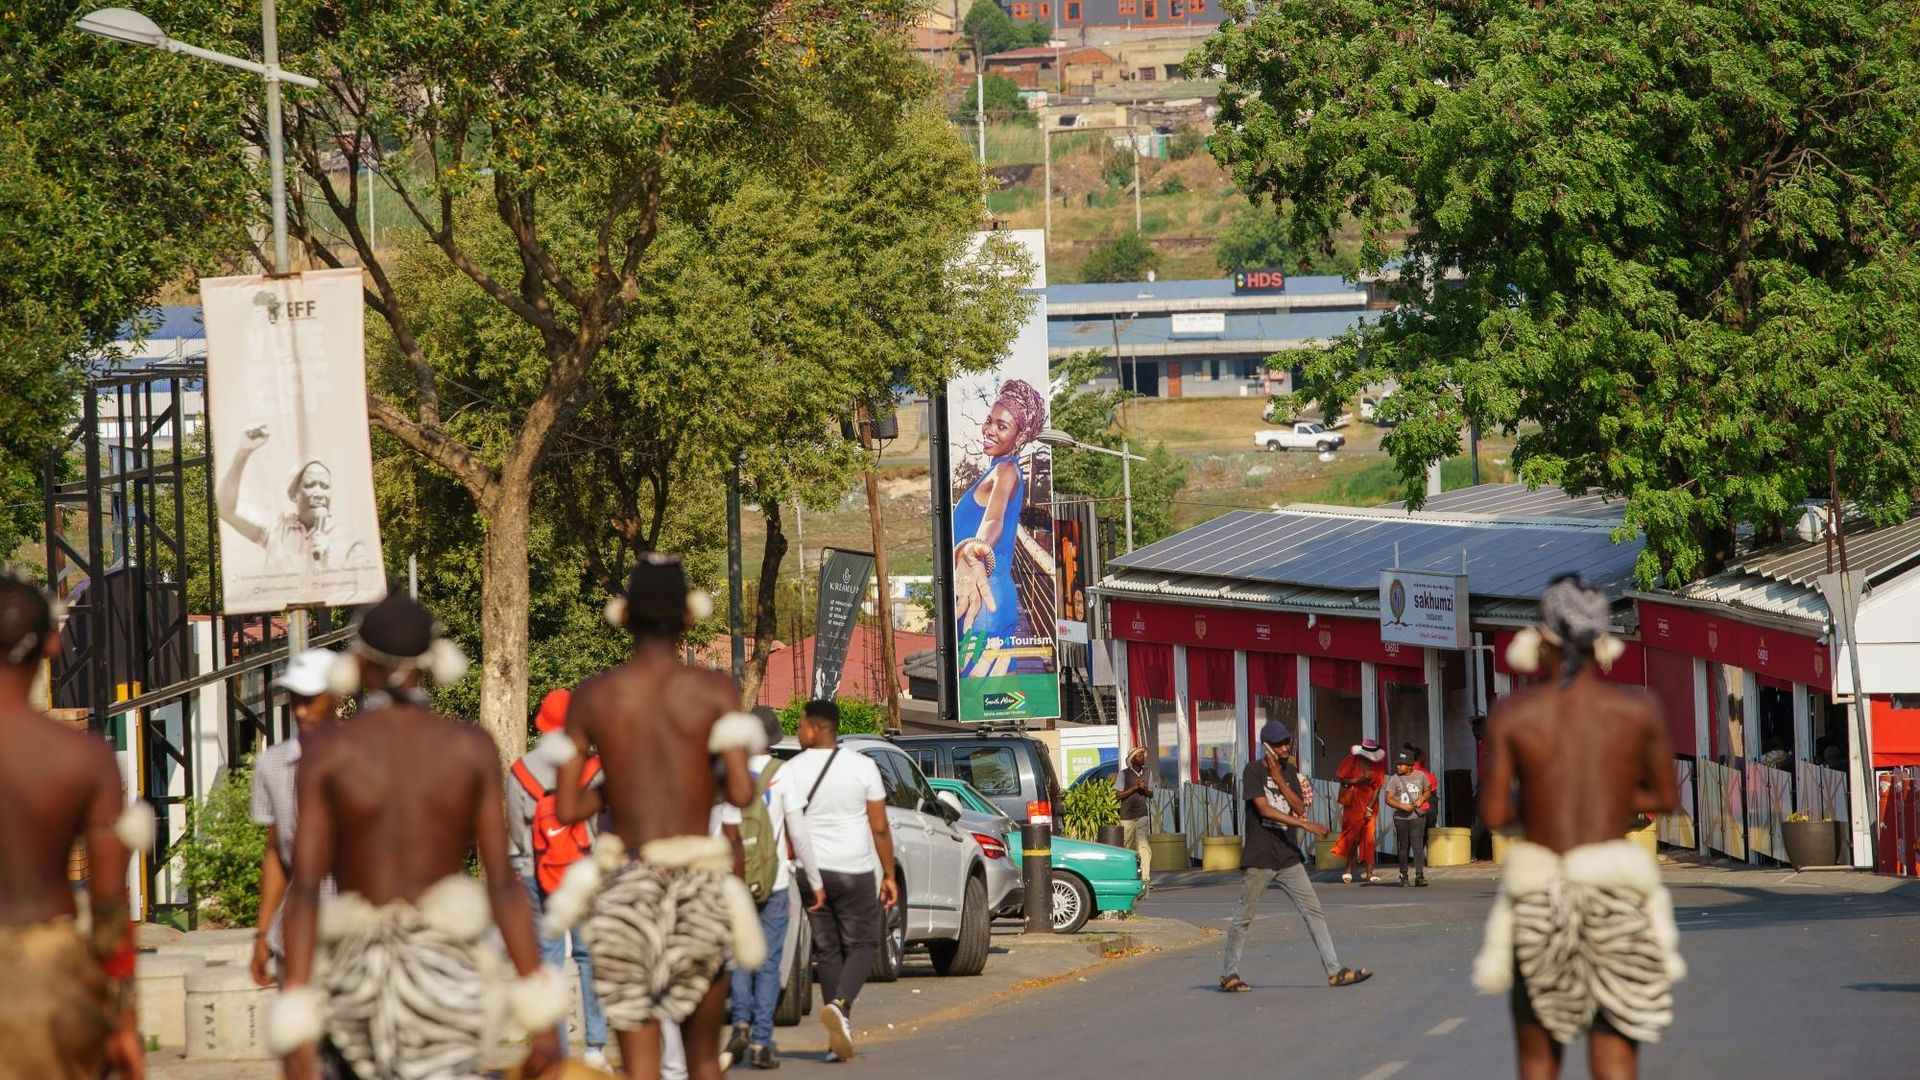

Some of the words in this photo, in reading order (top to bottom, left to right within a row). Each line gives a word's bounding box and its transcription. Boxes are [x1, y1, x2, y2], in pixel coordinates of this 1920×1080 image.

[1247, 271, 1283, 288] HDS
[286, 300, 316, 318] EFF
[1414, 591, 1454, 612] sakhumzi
[203, 1002, 216, 1050] TATA
